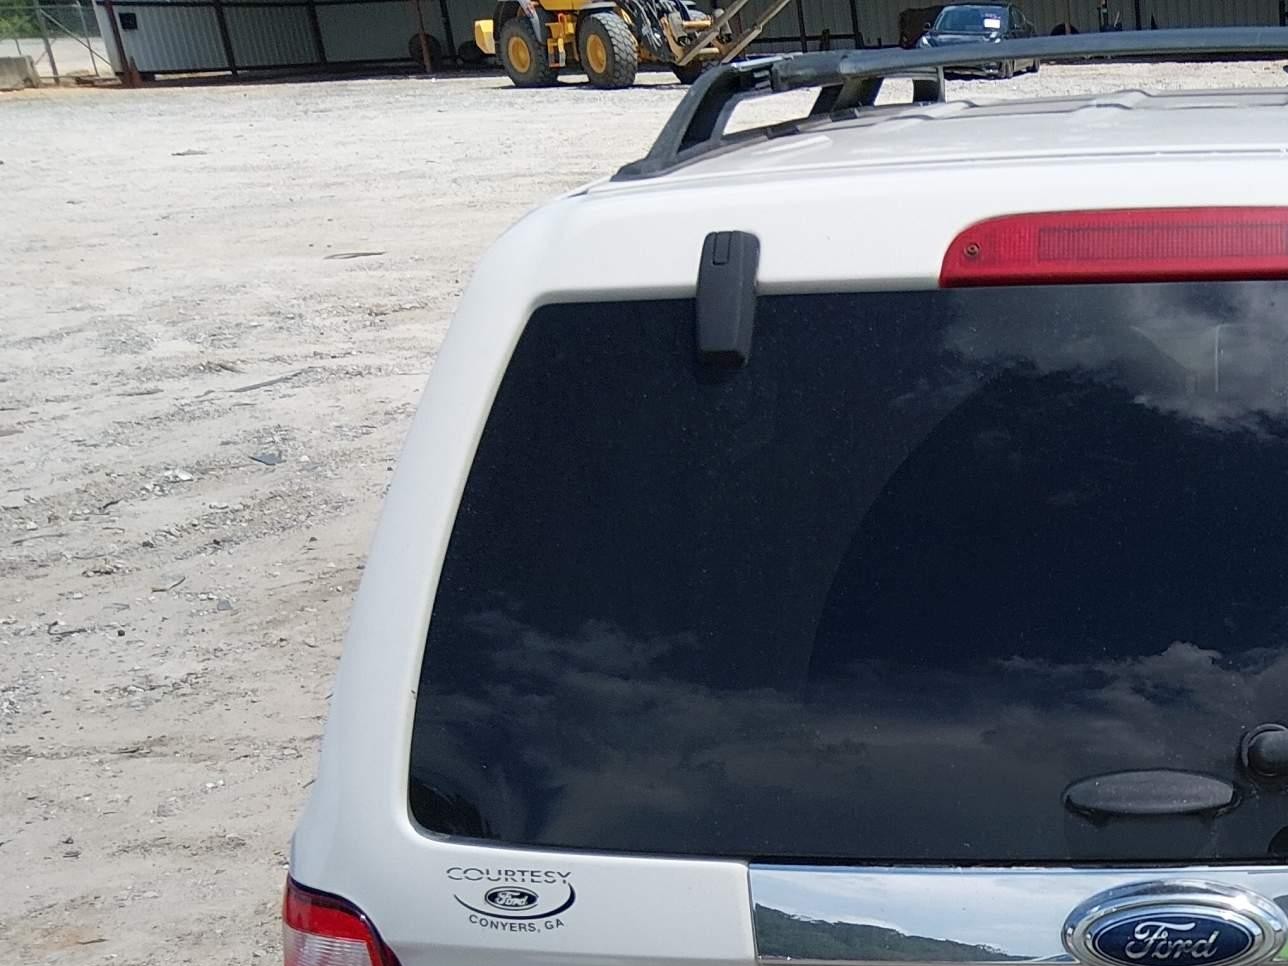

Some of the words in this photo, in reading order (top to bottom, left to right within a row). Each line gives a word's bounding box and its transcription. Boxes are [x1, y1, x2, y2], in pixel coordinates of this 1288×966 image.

[446, 867, 572, 884] COURTESY
[496, 891, 529, 906] Ford
[469, 914, 541, 933] CONYERS,
[544, 918, 565, 930] GA
[1125, 921, 1219, 959] Ford
